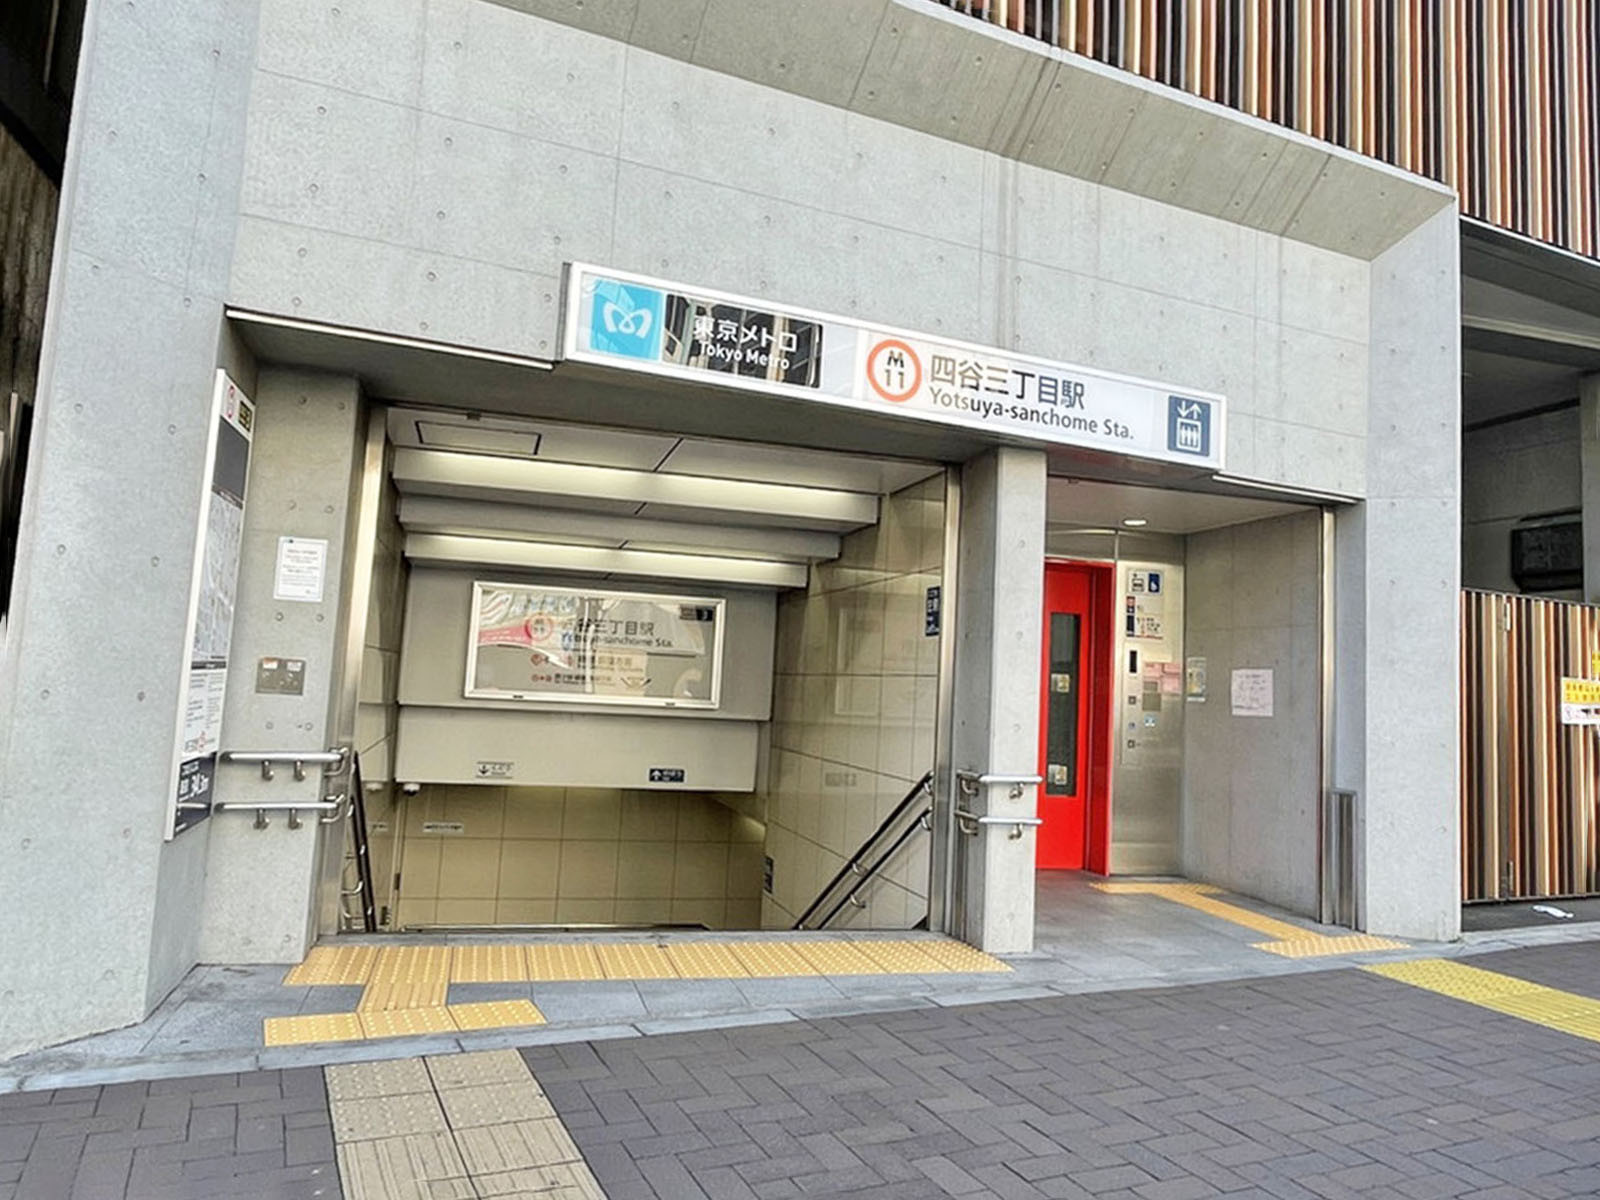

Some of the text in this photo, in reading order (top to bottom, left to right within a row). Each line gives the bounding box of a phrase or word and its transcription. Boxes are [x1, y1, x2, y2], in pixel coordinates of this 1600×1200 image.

[693, 315, 798, 352] 東京メトロ
[699, 340, 790, 370] Tokyo Metro
[886, 349, 905, 369] M
[884, 368, 905, 390] 11
[930, 353, 1086, 411] 四谷三丁目駅
[929, 385, 1135, 440] Yotsuya-sanchome Sta.
